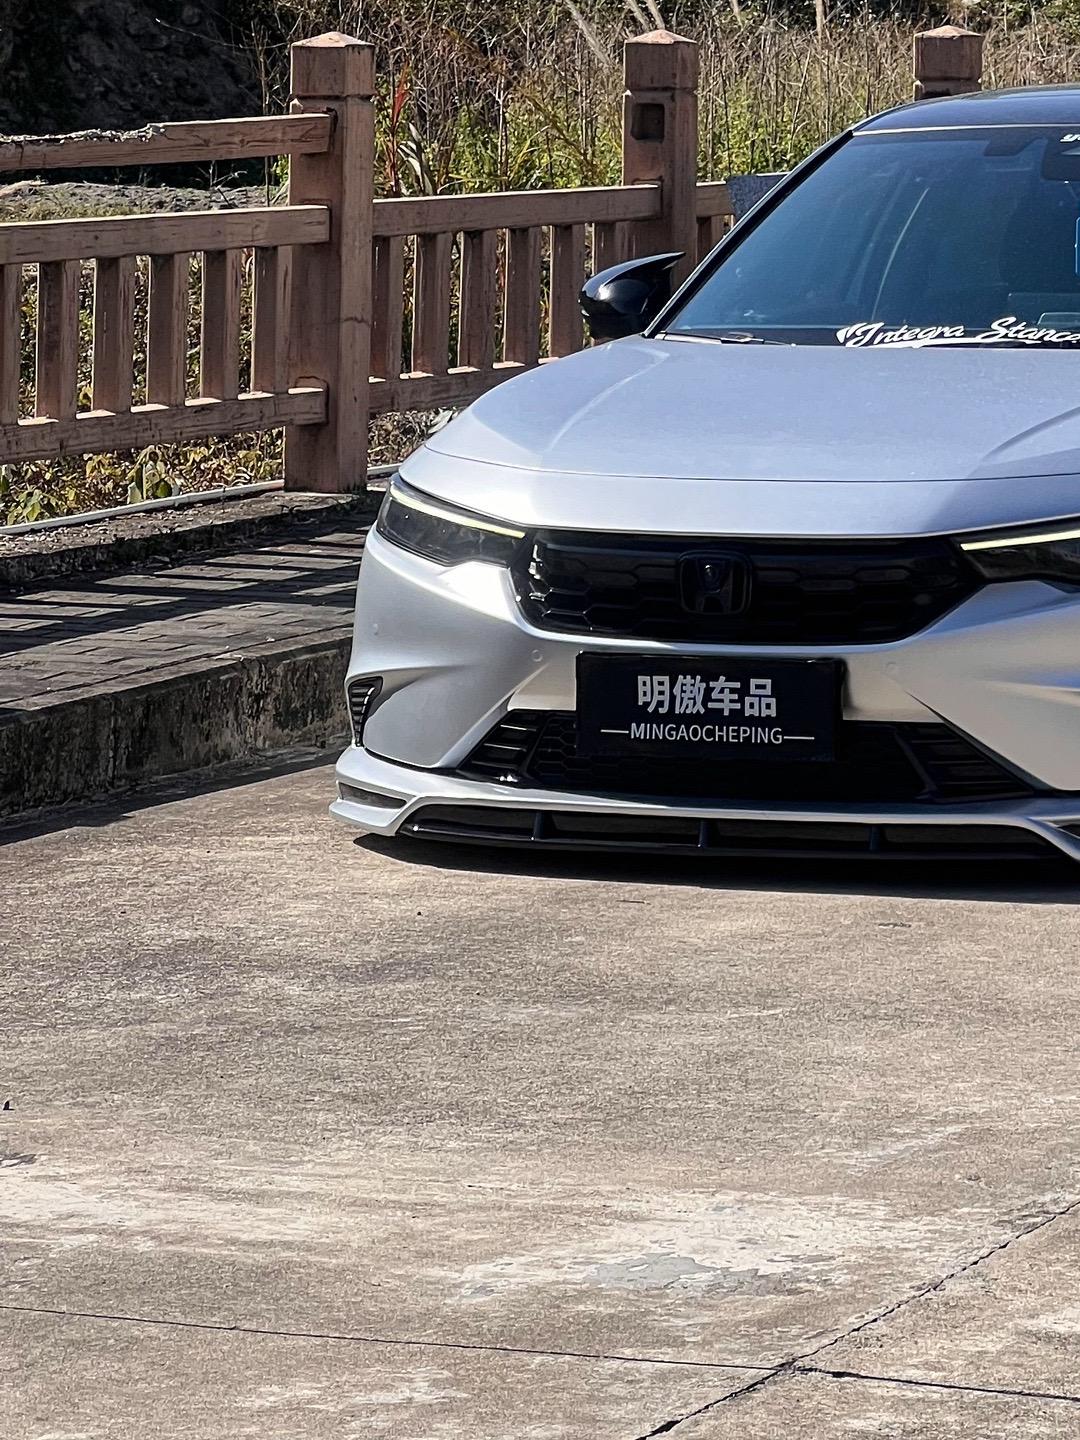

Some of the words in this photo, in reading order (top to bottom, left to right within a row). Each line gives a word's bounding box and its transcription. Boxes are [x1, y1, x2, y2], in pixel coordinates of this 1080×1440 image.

[836, 322, 965, 348] Integra
[637, 675, 777, 717] 明傲车品
[630, 722, 783, 744] MINGAOCHEPING
